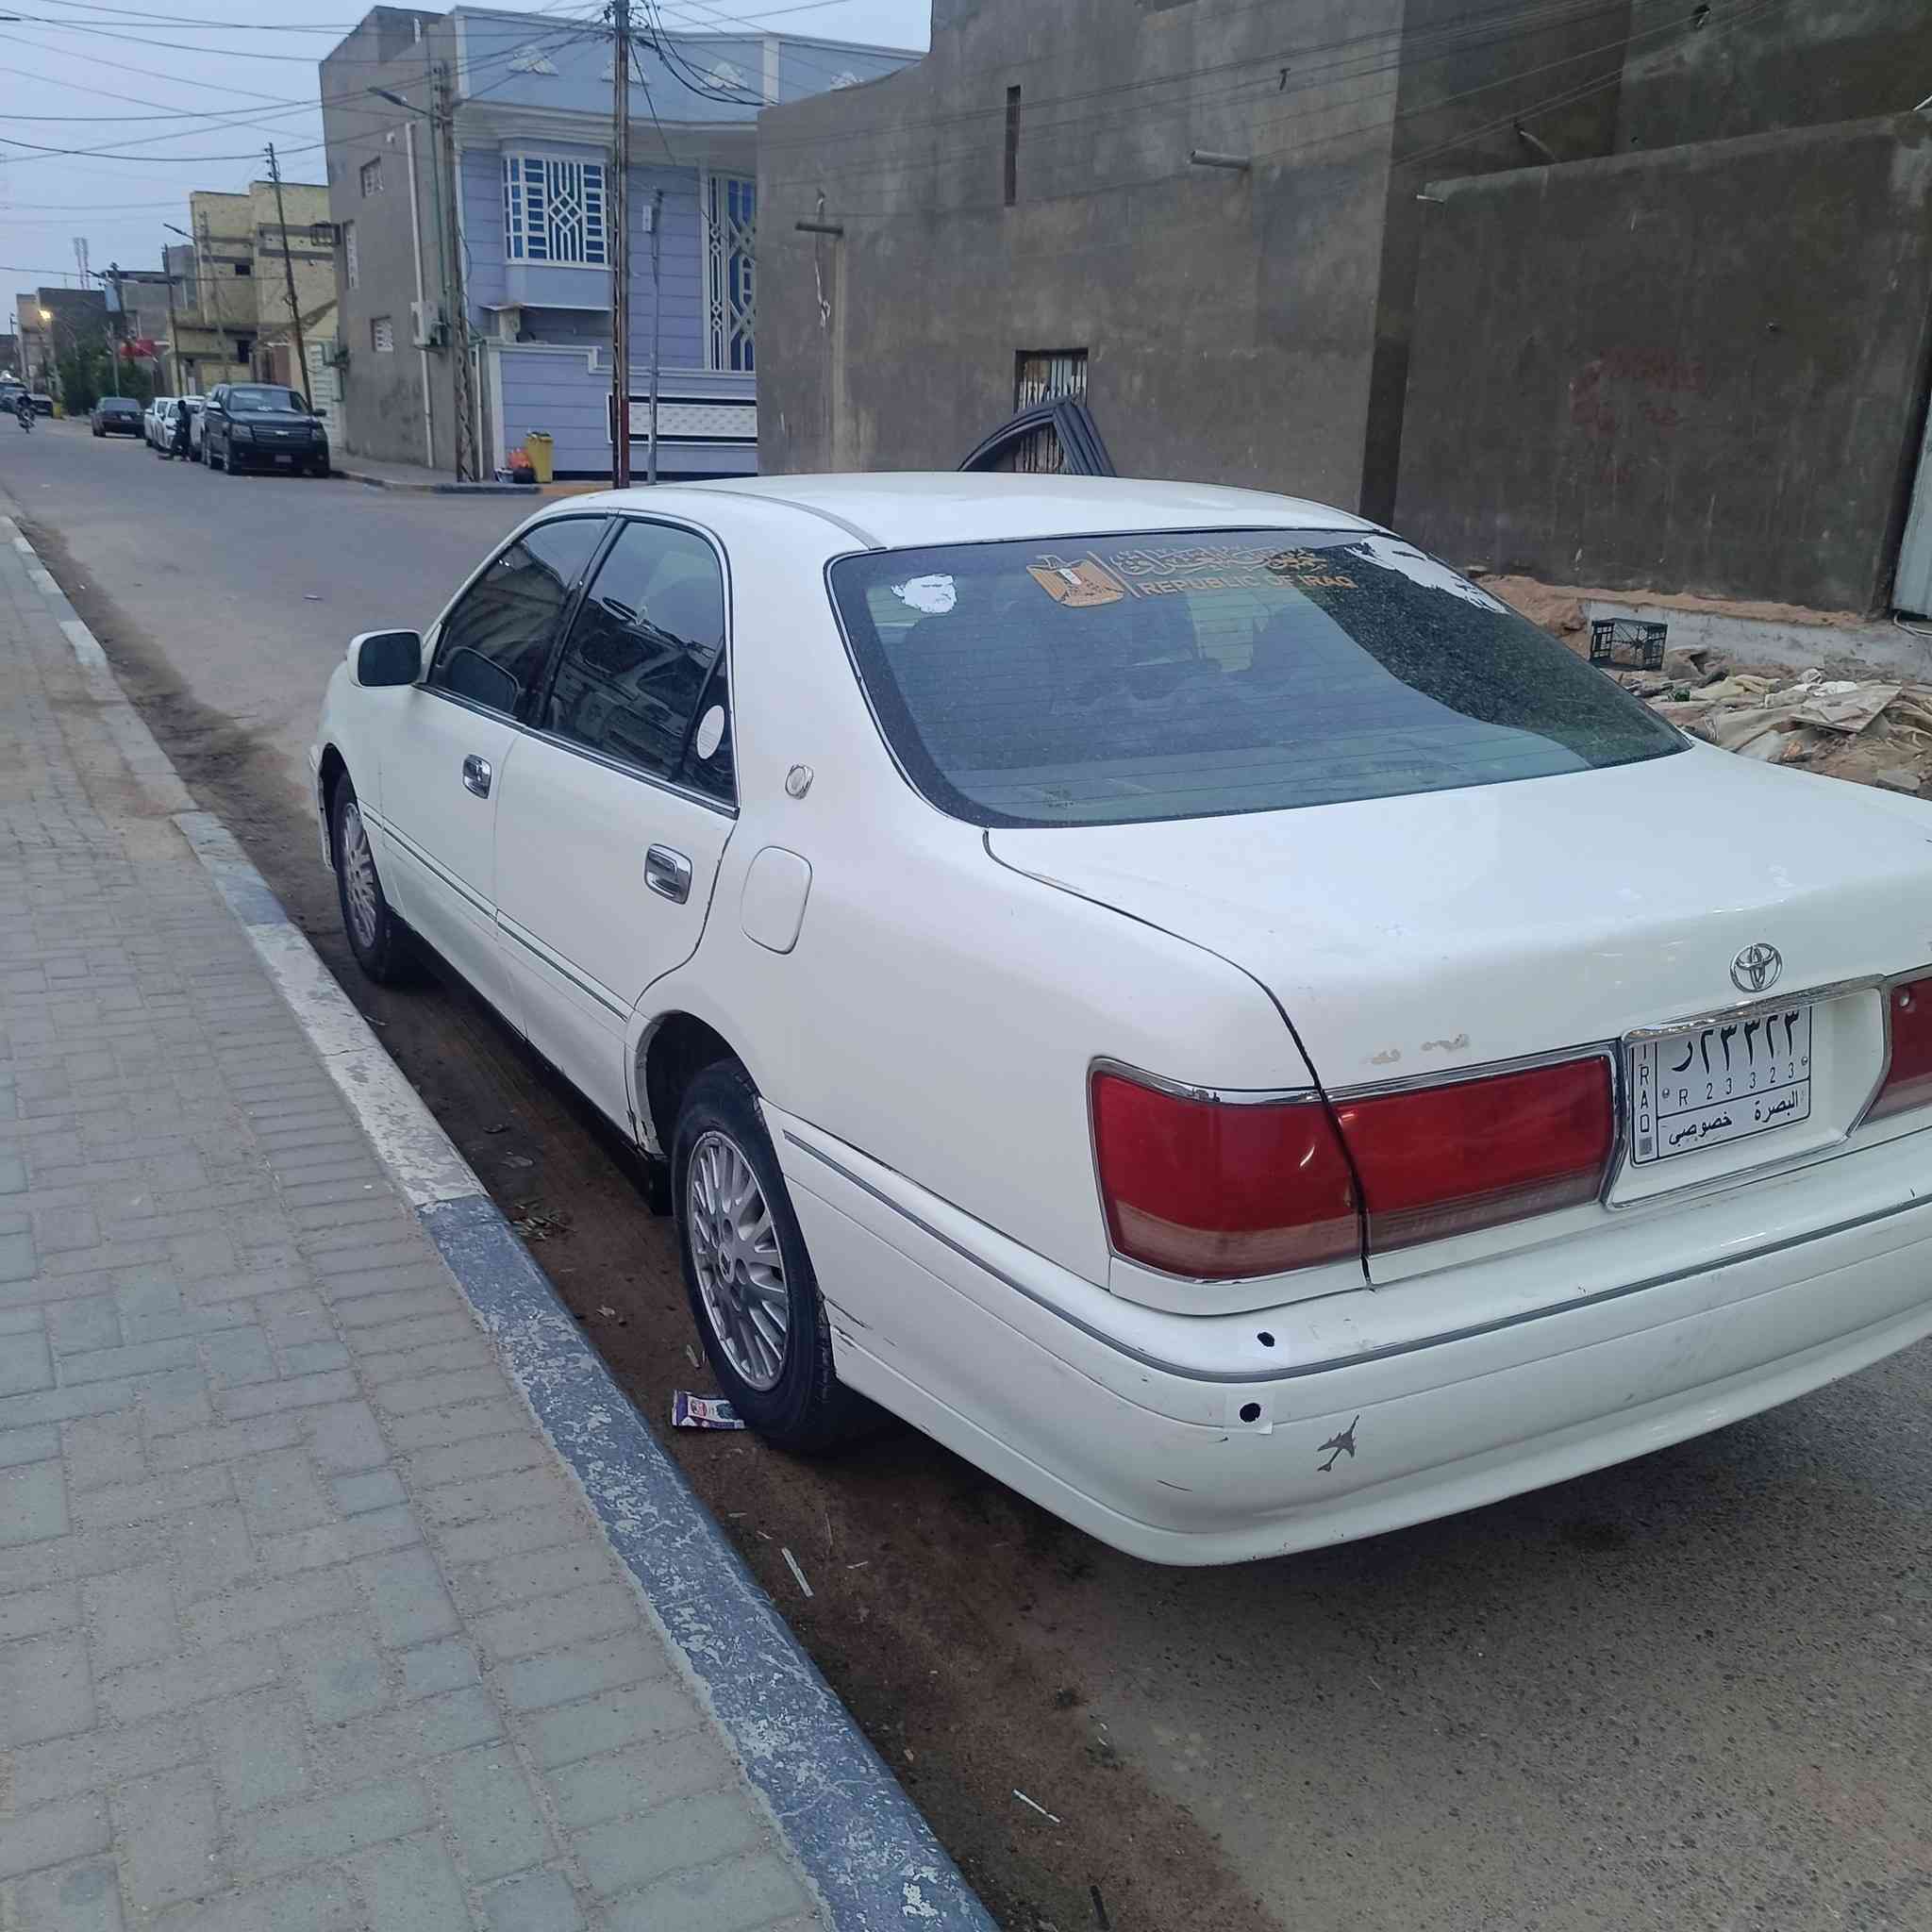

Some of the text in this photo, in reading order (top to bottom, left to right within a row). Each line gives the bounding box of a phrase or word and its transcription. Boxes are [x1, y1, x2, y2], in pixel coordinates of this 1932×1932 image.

[1136, 574, 1359, 596] REPUBLIC OF IRAQ
[1705, 1062, 1796, 1100] 23323
[1668, 1091, 1799, 1147] البصرة خصوصي
